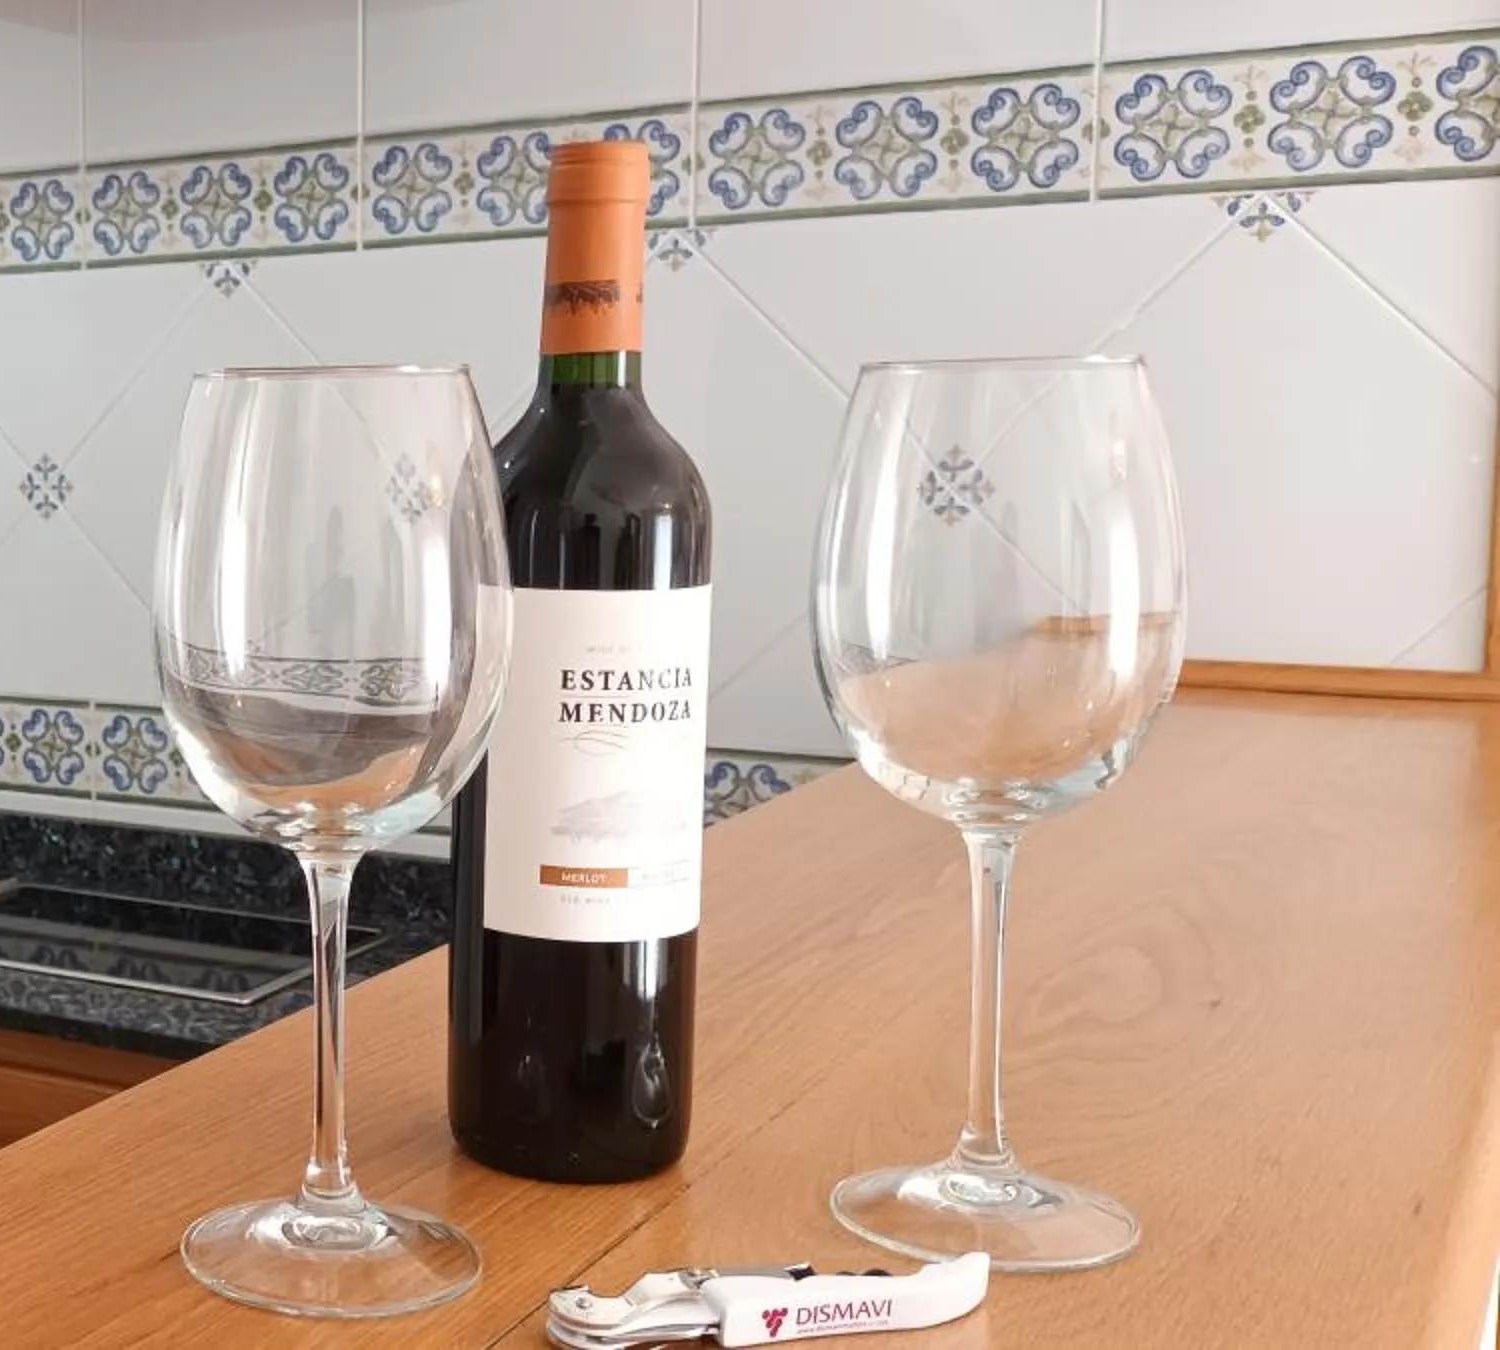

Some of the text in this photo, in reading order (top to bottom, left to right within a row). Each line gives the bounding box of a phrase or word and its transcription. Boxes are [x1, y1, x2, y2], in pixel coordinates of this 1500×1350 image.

[559, 667, 692, 691] ESTANCIA
[557, 699, 692, 723] MENDOZA
[560, 872, 609, 885] MERLOT
[796, 1299, 892, 1326] DISMAVI
